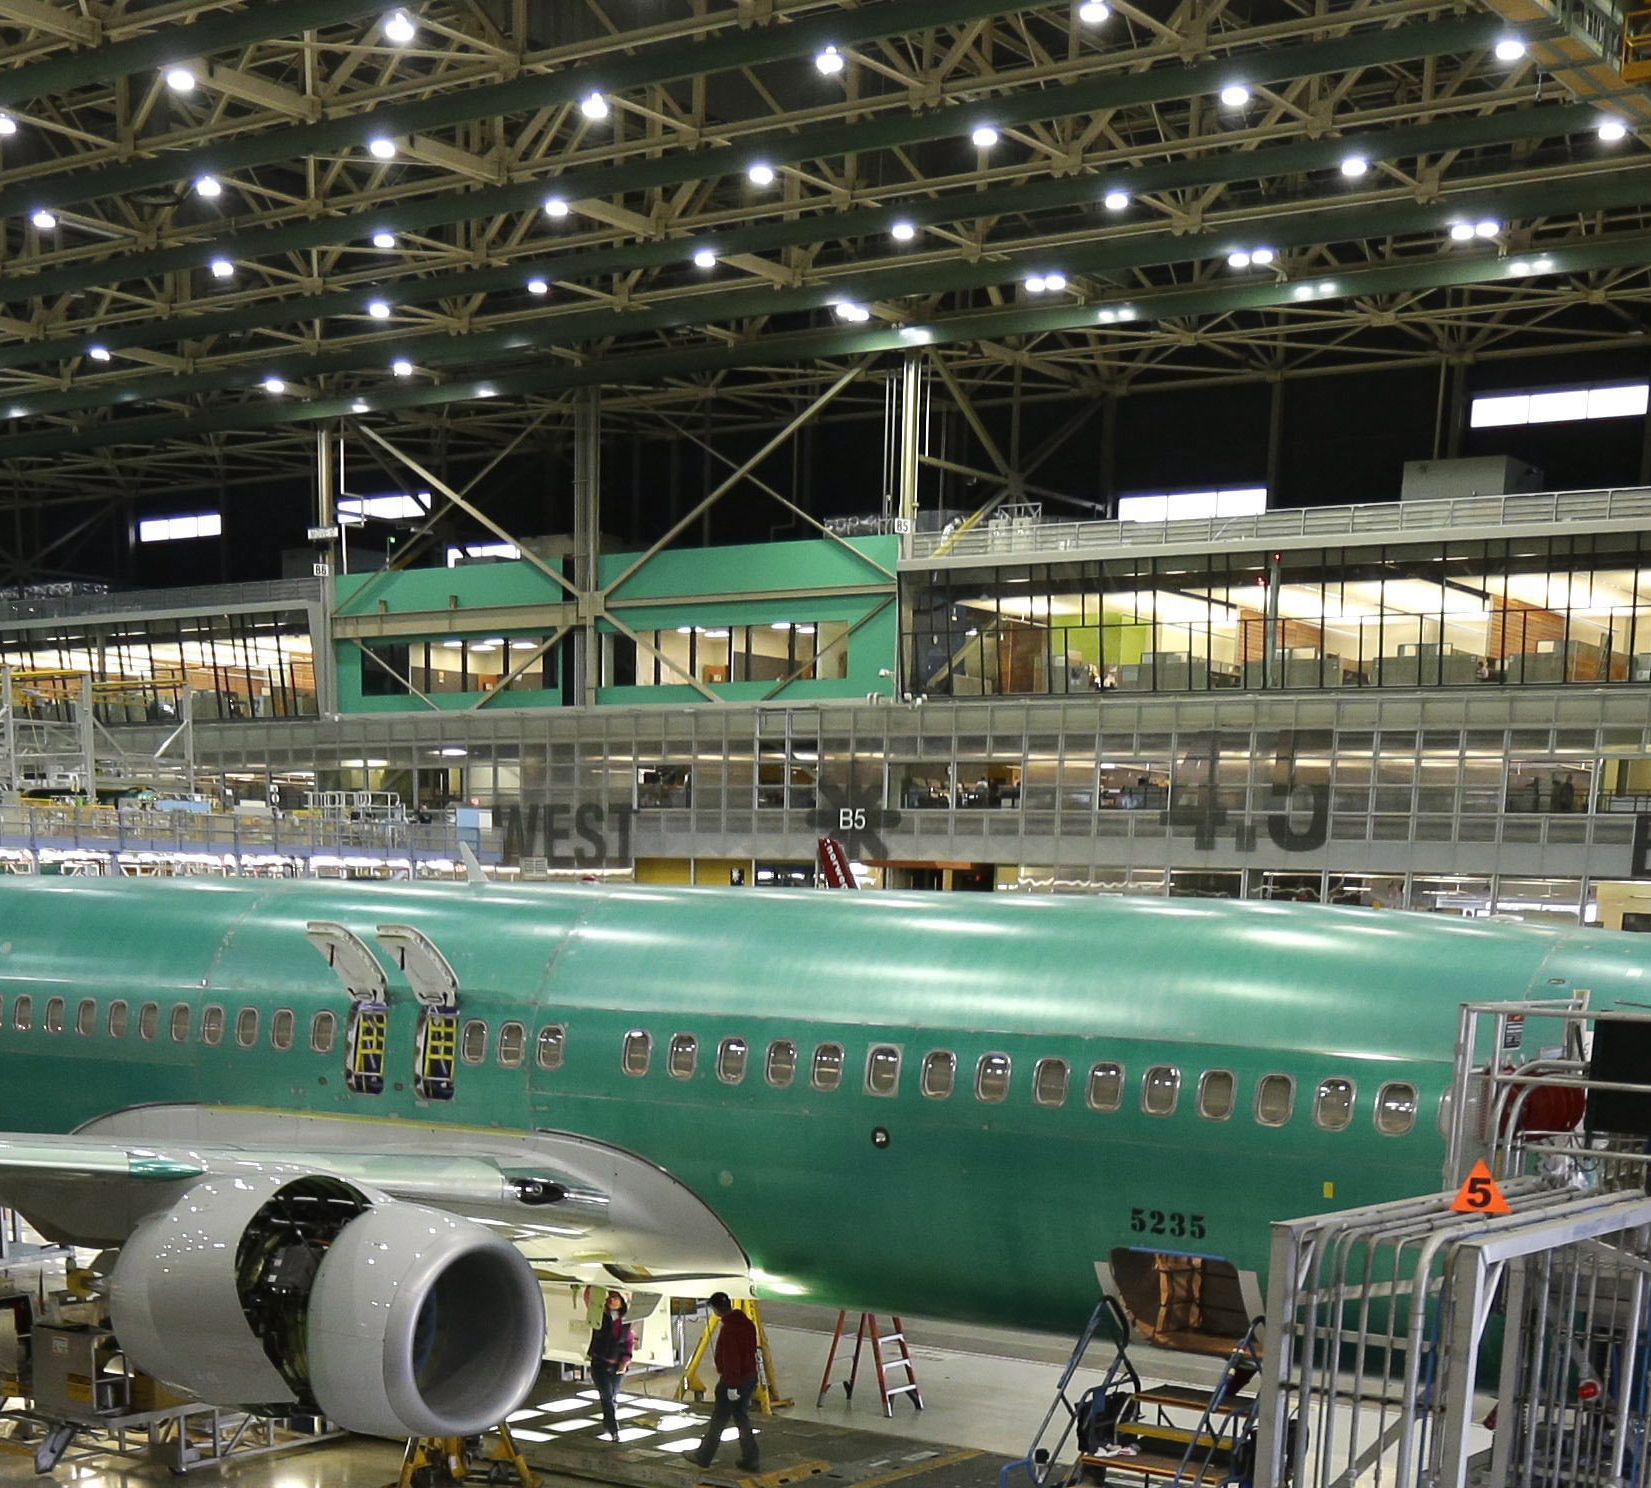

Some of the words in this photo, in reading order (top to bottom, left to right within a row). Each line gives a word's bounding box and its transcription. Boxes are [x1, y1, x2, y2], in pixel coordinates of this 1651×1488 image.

[1159, 730, 1334, 852] 4.5
[492, 802, 633, 868] WEST
[839, 808, 866, 830] B5
[1466, 1176, 1492, 1208] 5
[1130, 1207, 1207, 1239] 5235
